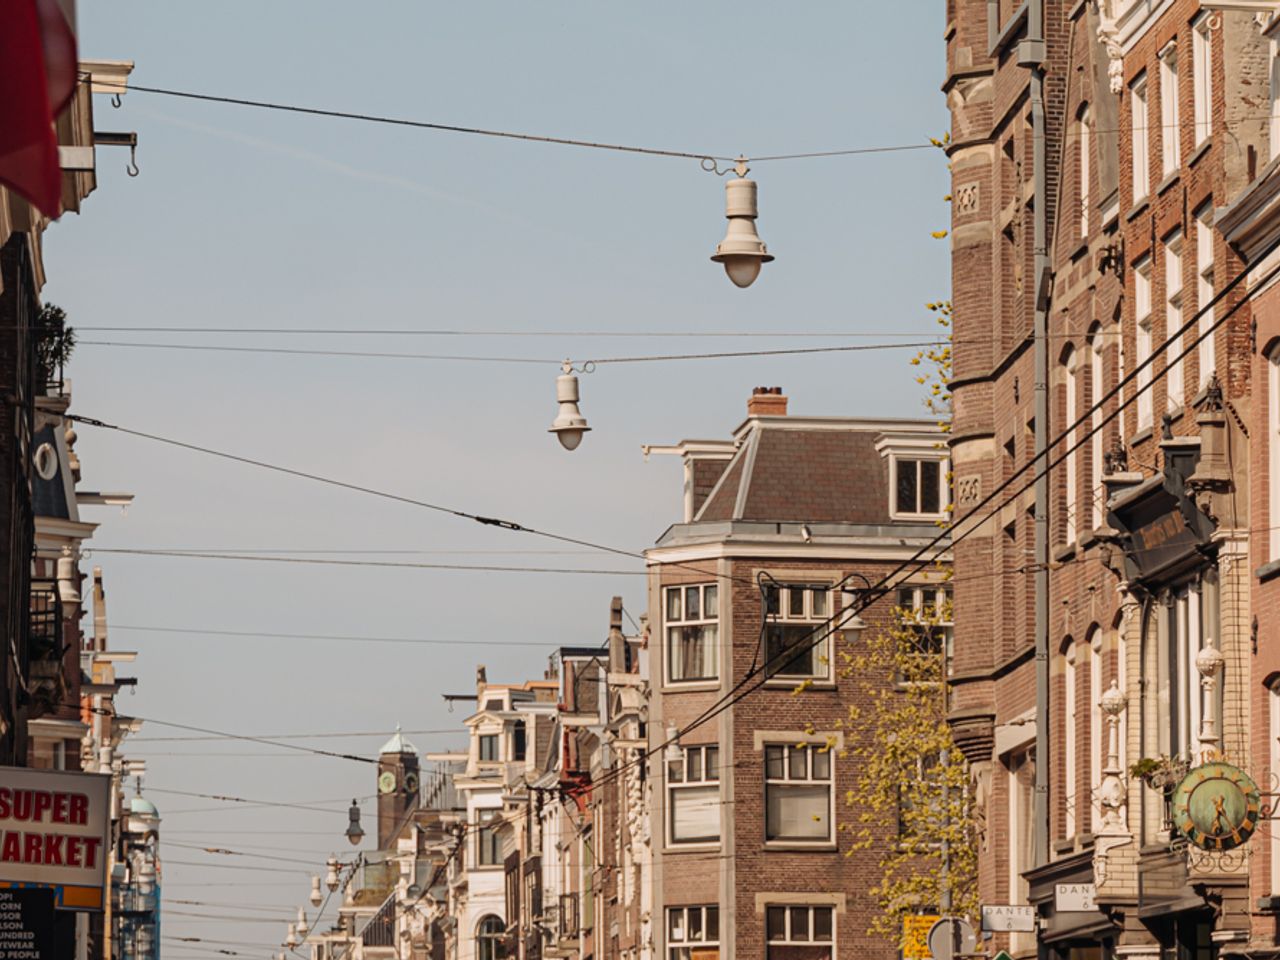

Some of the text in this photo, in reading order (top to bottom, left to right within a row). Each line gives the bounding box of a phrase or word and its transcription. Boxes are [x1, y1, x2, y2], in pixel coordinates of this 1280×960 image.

[0, 786, 89, 826] SUPER
[0, 829, 102, 869] ARKET
[1060, 886, 1090, 894] DAN
[1082, 901, 1089, 909] 6
[985, 907, 1031, 916] DANTE
